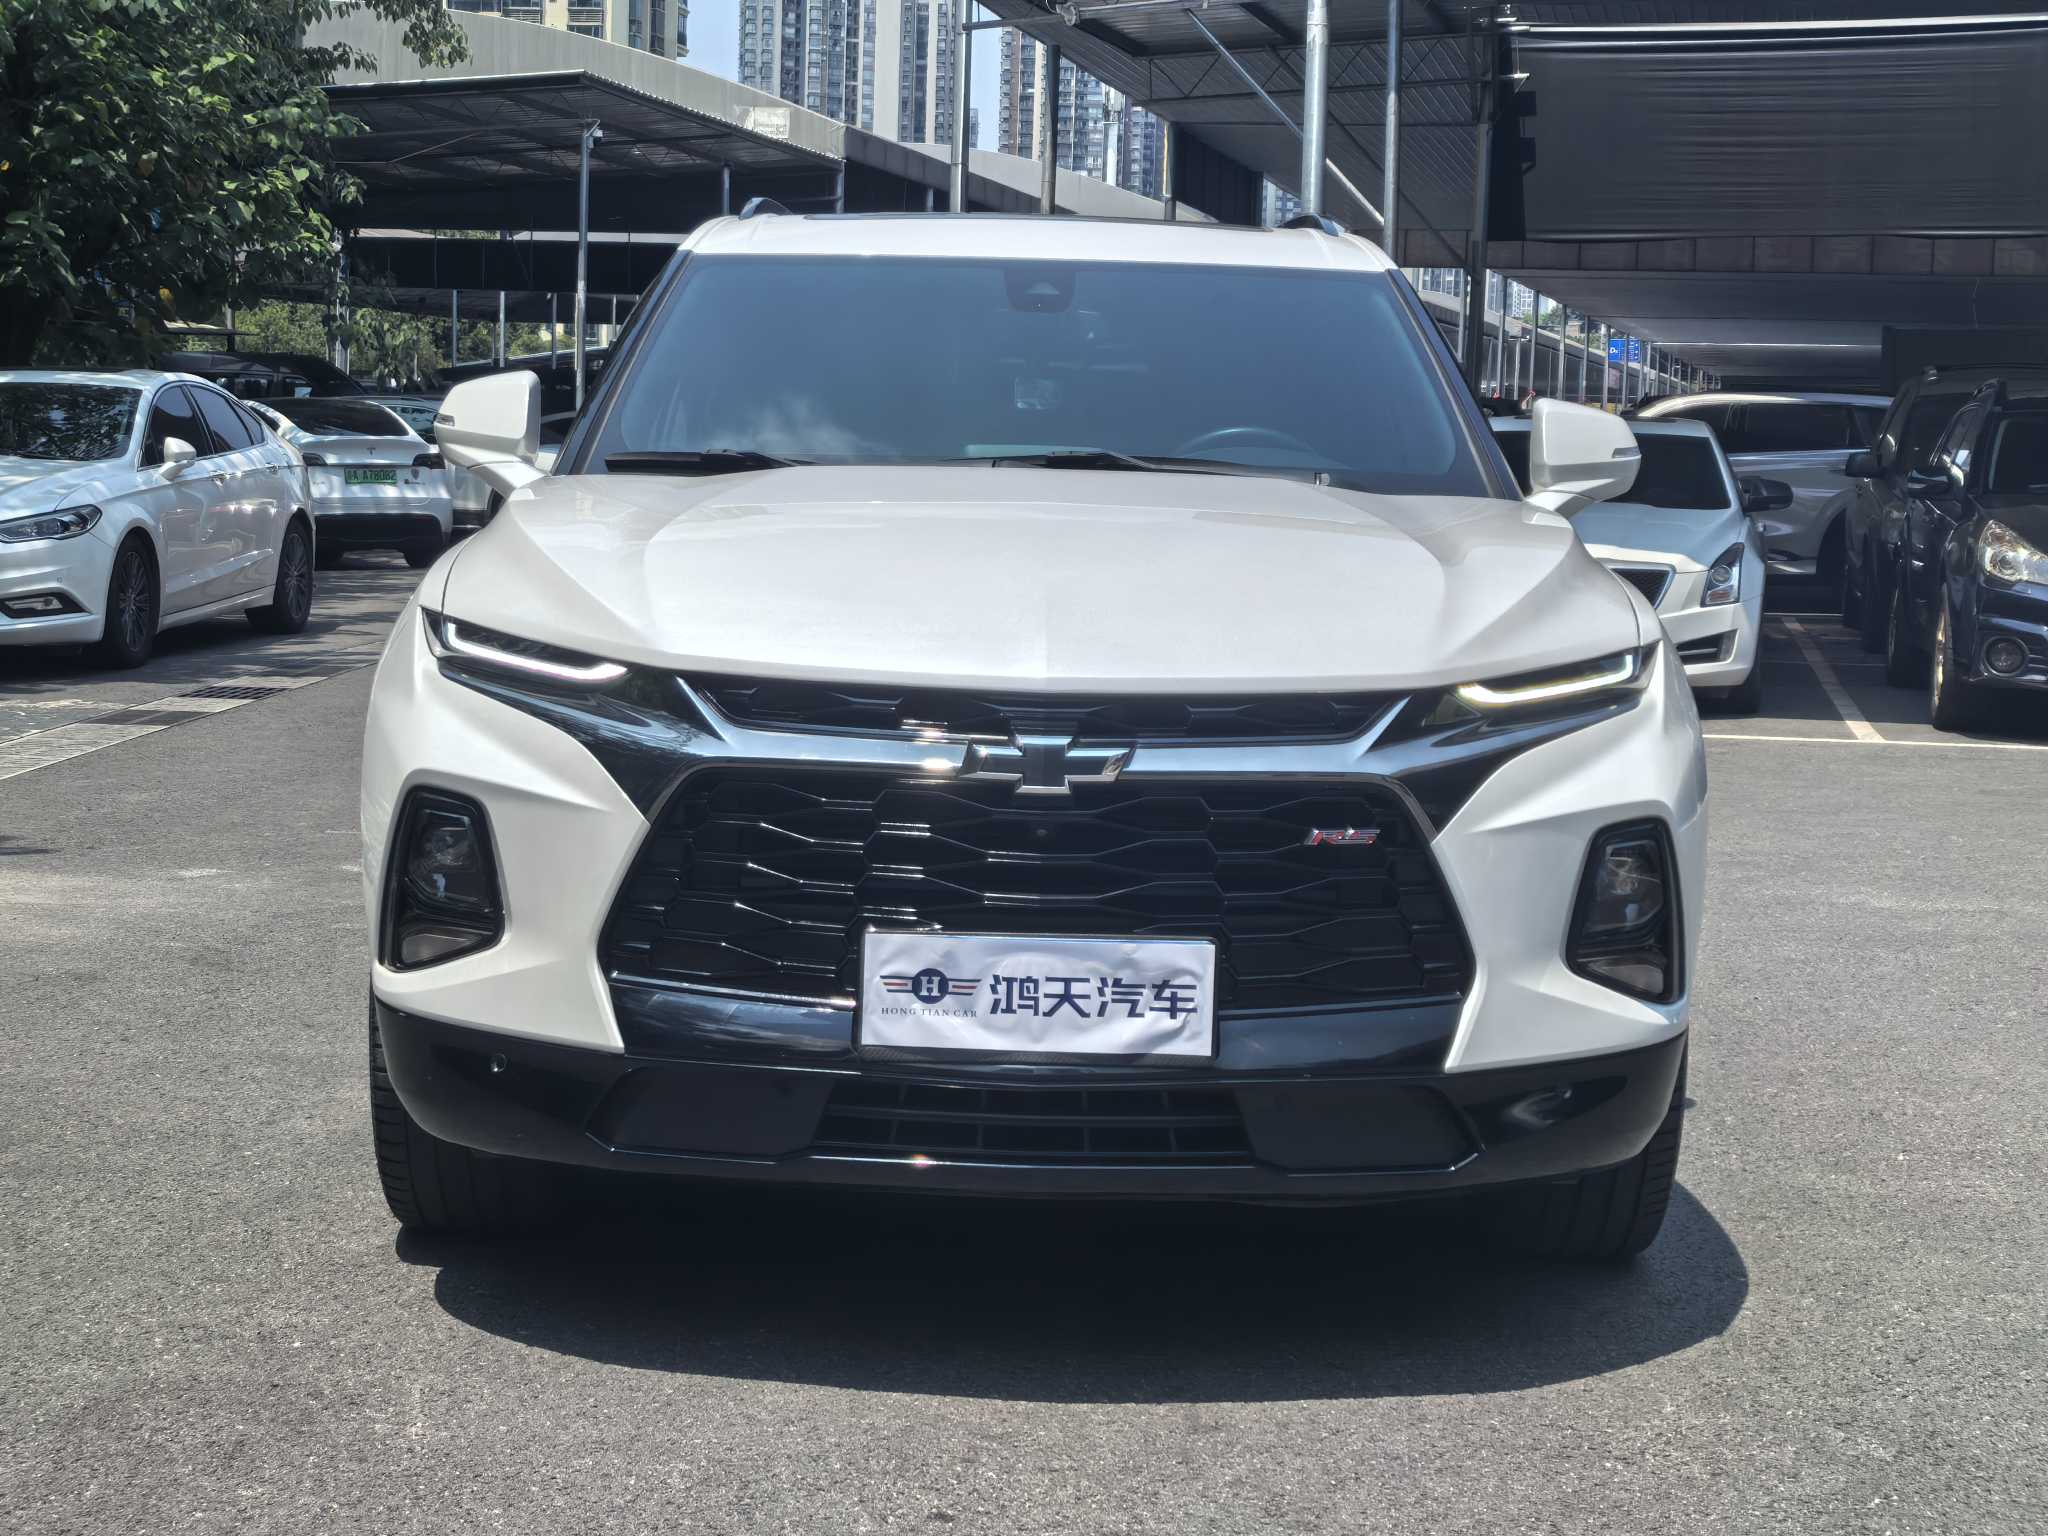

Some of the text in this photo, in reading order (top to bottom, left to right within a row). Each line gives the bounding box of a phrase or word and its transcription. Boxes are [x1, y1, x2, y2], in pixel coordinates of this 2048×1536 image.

[1304, 828, 1381, 846] RS
[920, 976, 942, 997] H
[989, 974, 1198, 1019] 鸿天汽车
[881, 1006, 978, 1018] HONG TIAN CAR
